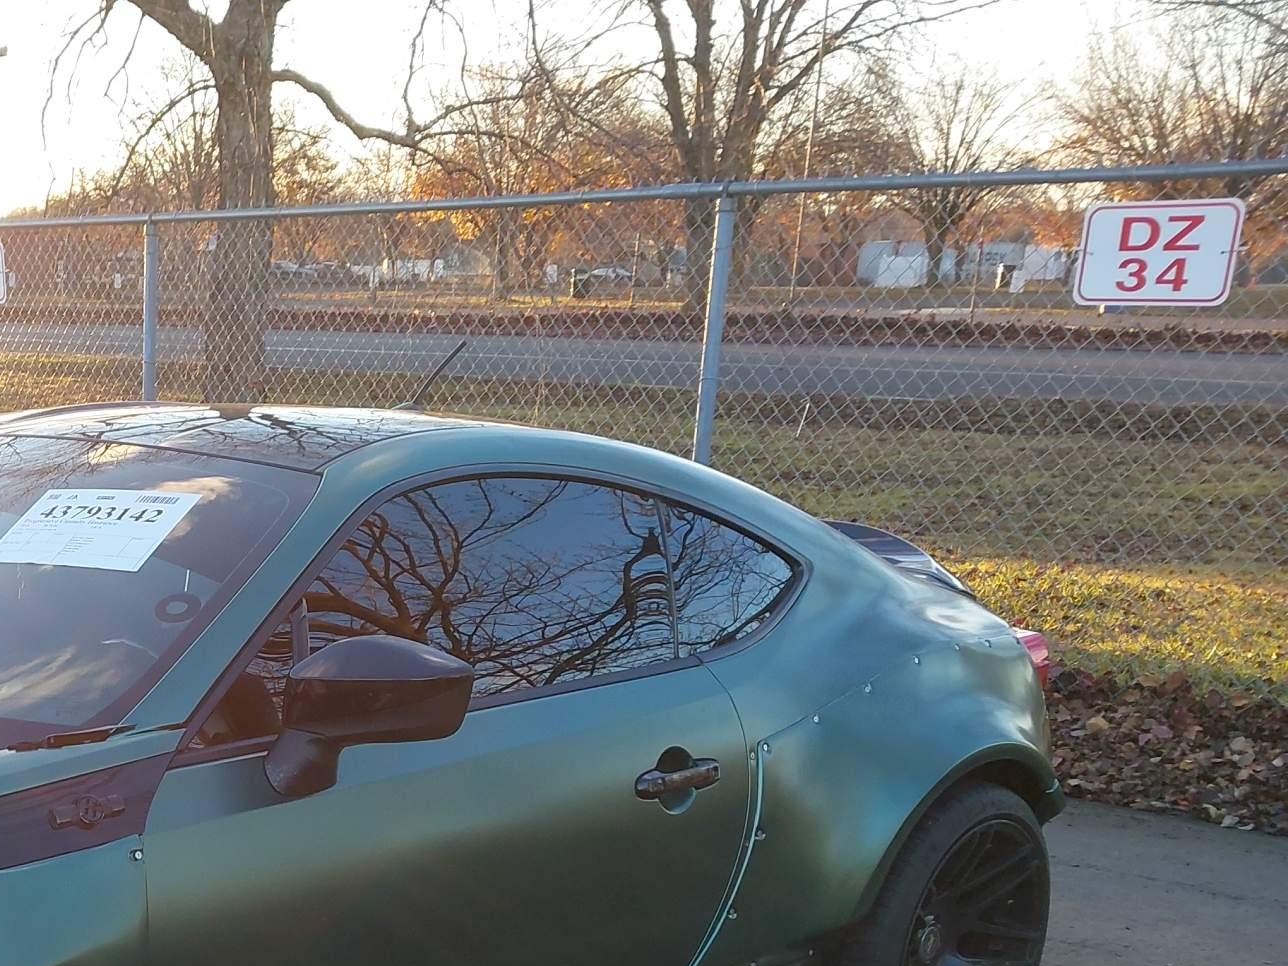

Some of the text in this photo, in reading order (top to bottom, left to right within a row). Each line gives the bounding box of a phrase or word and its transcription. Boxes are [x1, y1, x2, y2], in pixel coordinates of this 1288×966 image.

[1118, 215, 1206, 252] DZ
[1115, 257, 1188, 292] 34
[40, 504, 164, 523] 43793142
